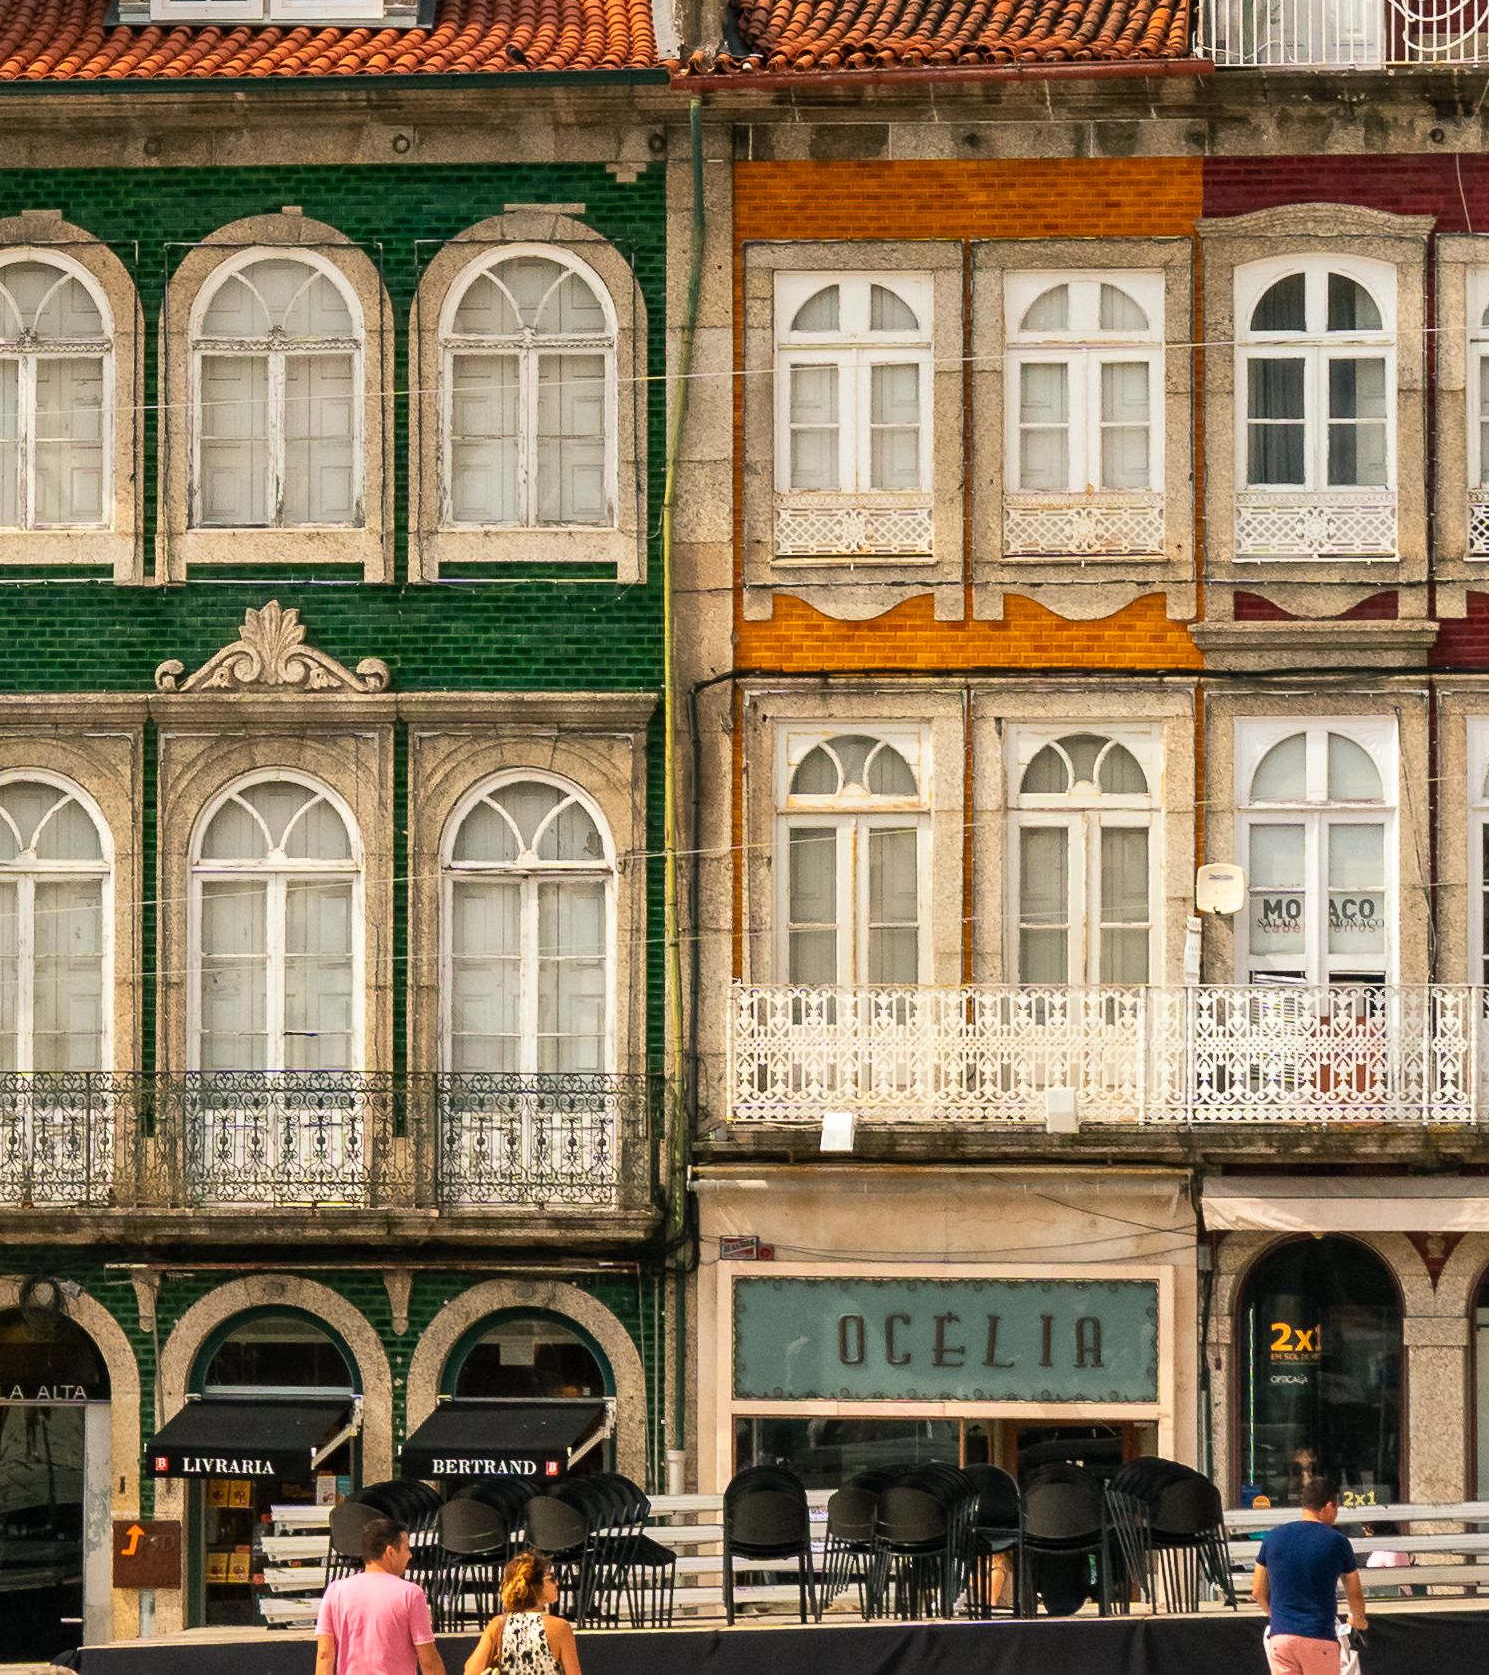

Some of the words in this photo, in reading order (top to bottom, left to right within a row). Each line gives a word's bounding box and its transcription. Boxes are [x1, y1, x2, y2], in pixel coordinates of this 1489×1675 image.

[1263, 898, 1376, 920] MOACO
[838, 1310, 1105, 1368] OCELIA
[36, 1384, 88, 1400] ALTA
[182, 1457, 275, 1475] LIVRARIA
[432, 1458, 537, 1475] BERTRAND
[1342, 1490, 1377, 1508] 2x1
